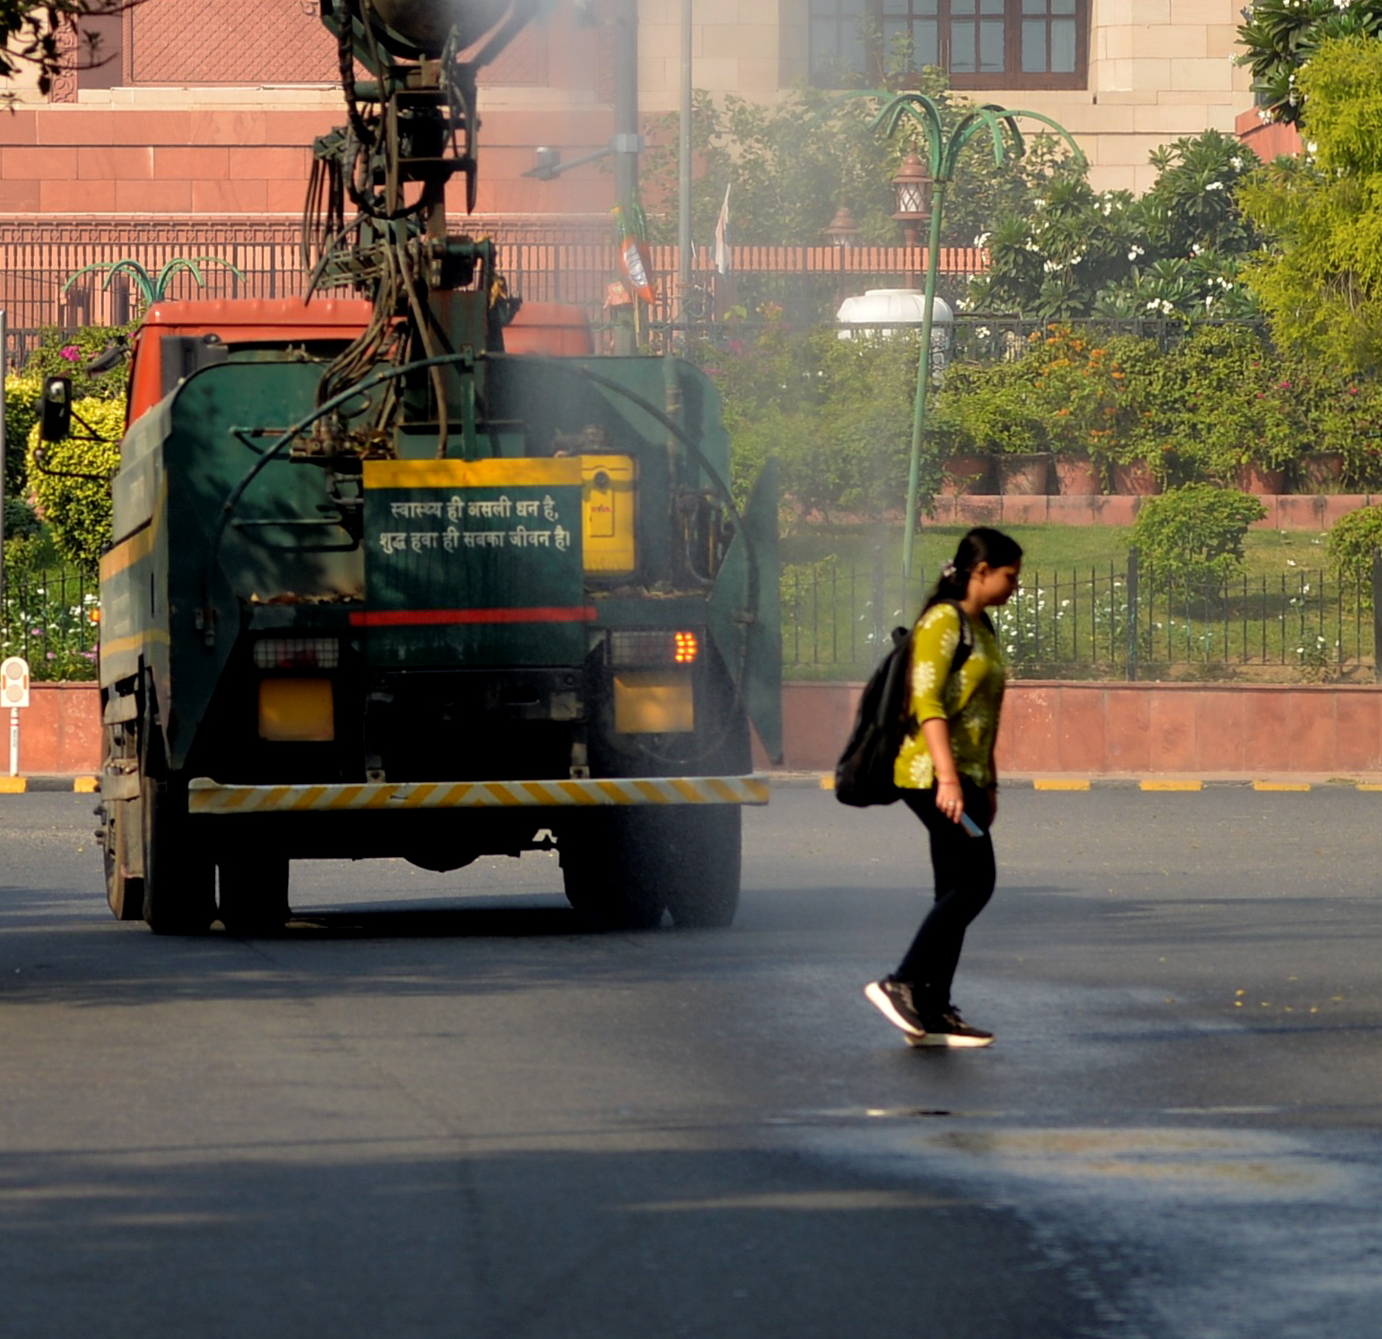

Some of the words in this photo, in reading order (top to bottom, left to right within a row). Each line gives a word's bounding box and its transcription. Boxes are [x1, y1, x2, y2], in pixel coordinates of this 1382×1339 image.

[446, 496, 465, 522] ही
[468, 496, 511, 518] असली
[410, 532, 439, 553] हवा
[442, 526, 461, 553] ही
[509, 525, 551, 548] जीवन
